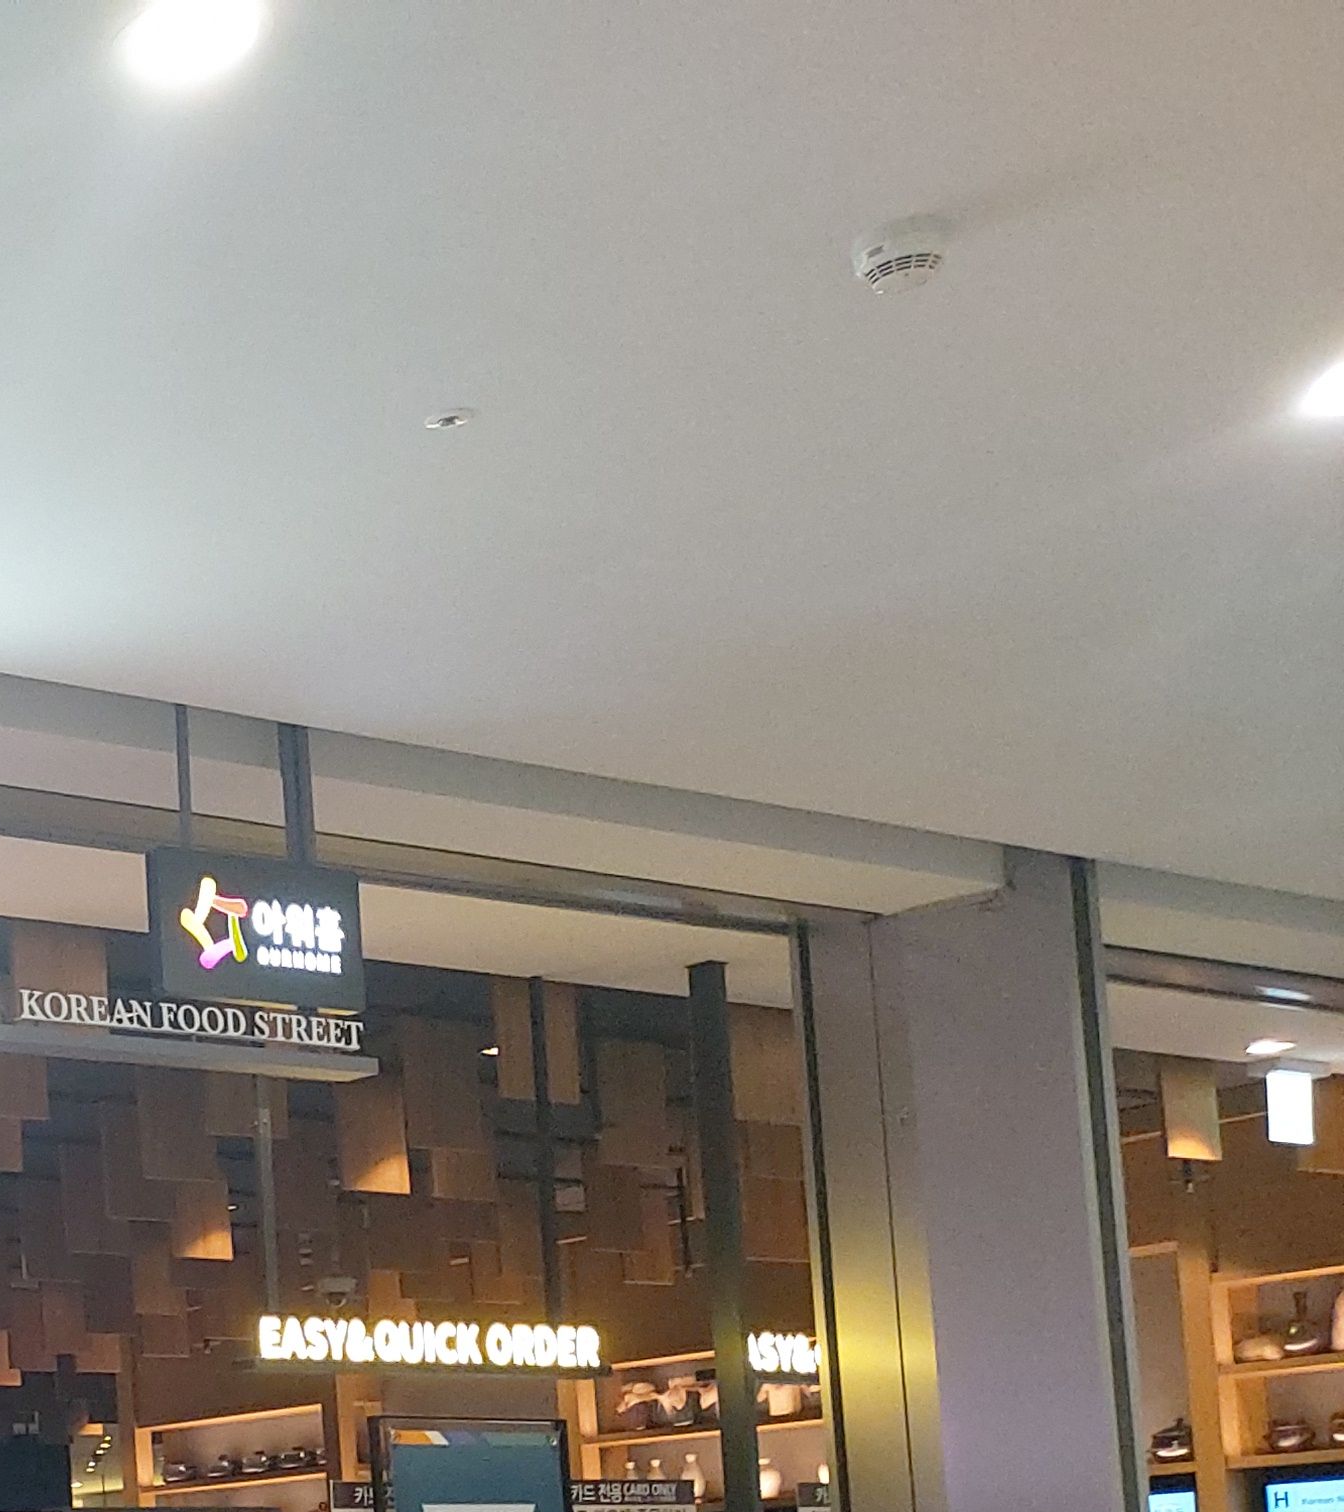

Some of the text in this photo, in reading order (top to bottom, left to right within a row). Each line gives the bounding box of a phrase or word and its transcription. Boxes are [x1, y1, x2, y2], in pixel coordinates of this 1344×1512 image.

[19, 989, 364, 1050] KOREAN FOOD STREET
[259, 1315, 600, 1367] EASY&QUICK ORDER
[598, 1483, 622, 1503] 전용
[1274, 1491, 1289, 1508] H
